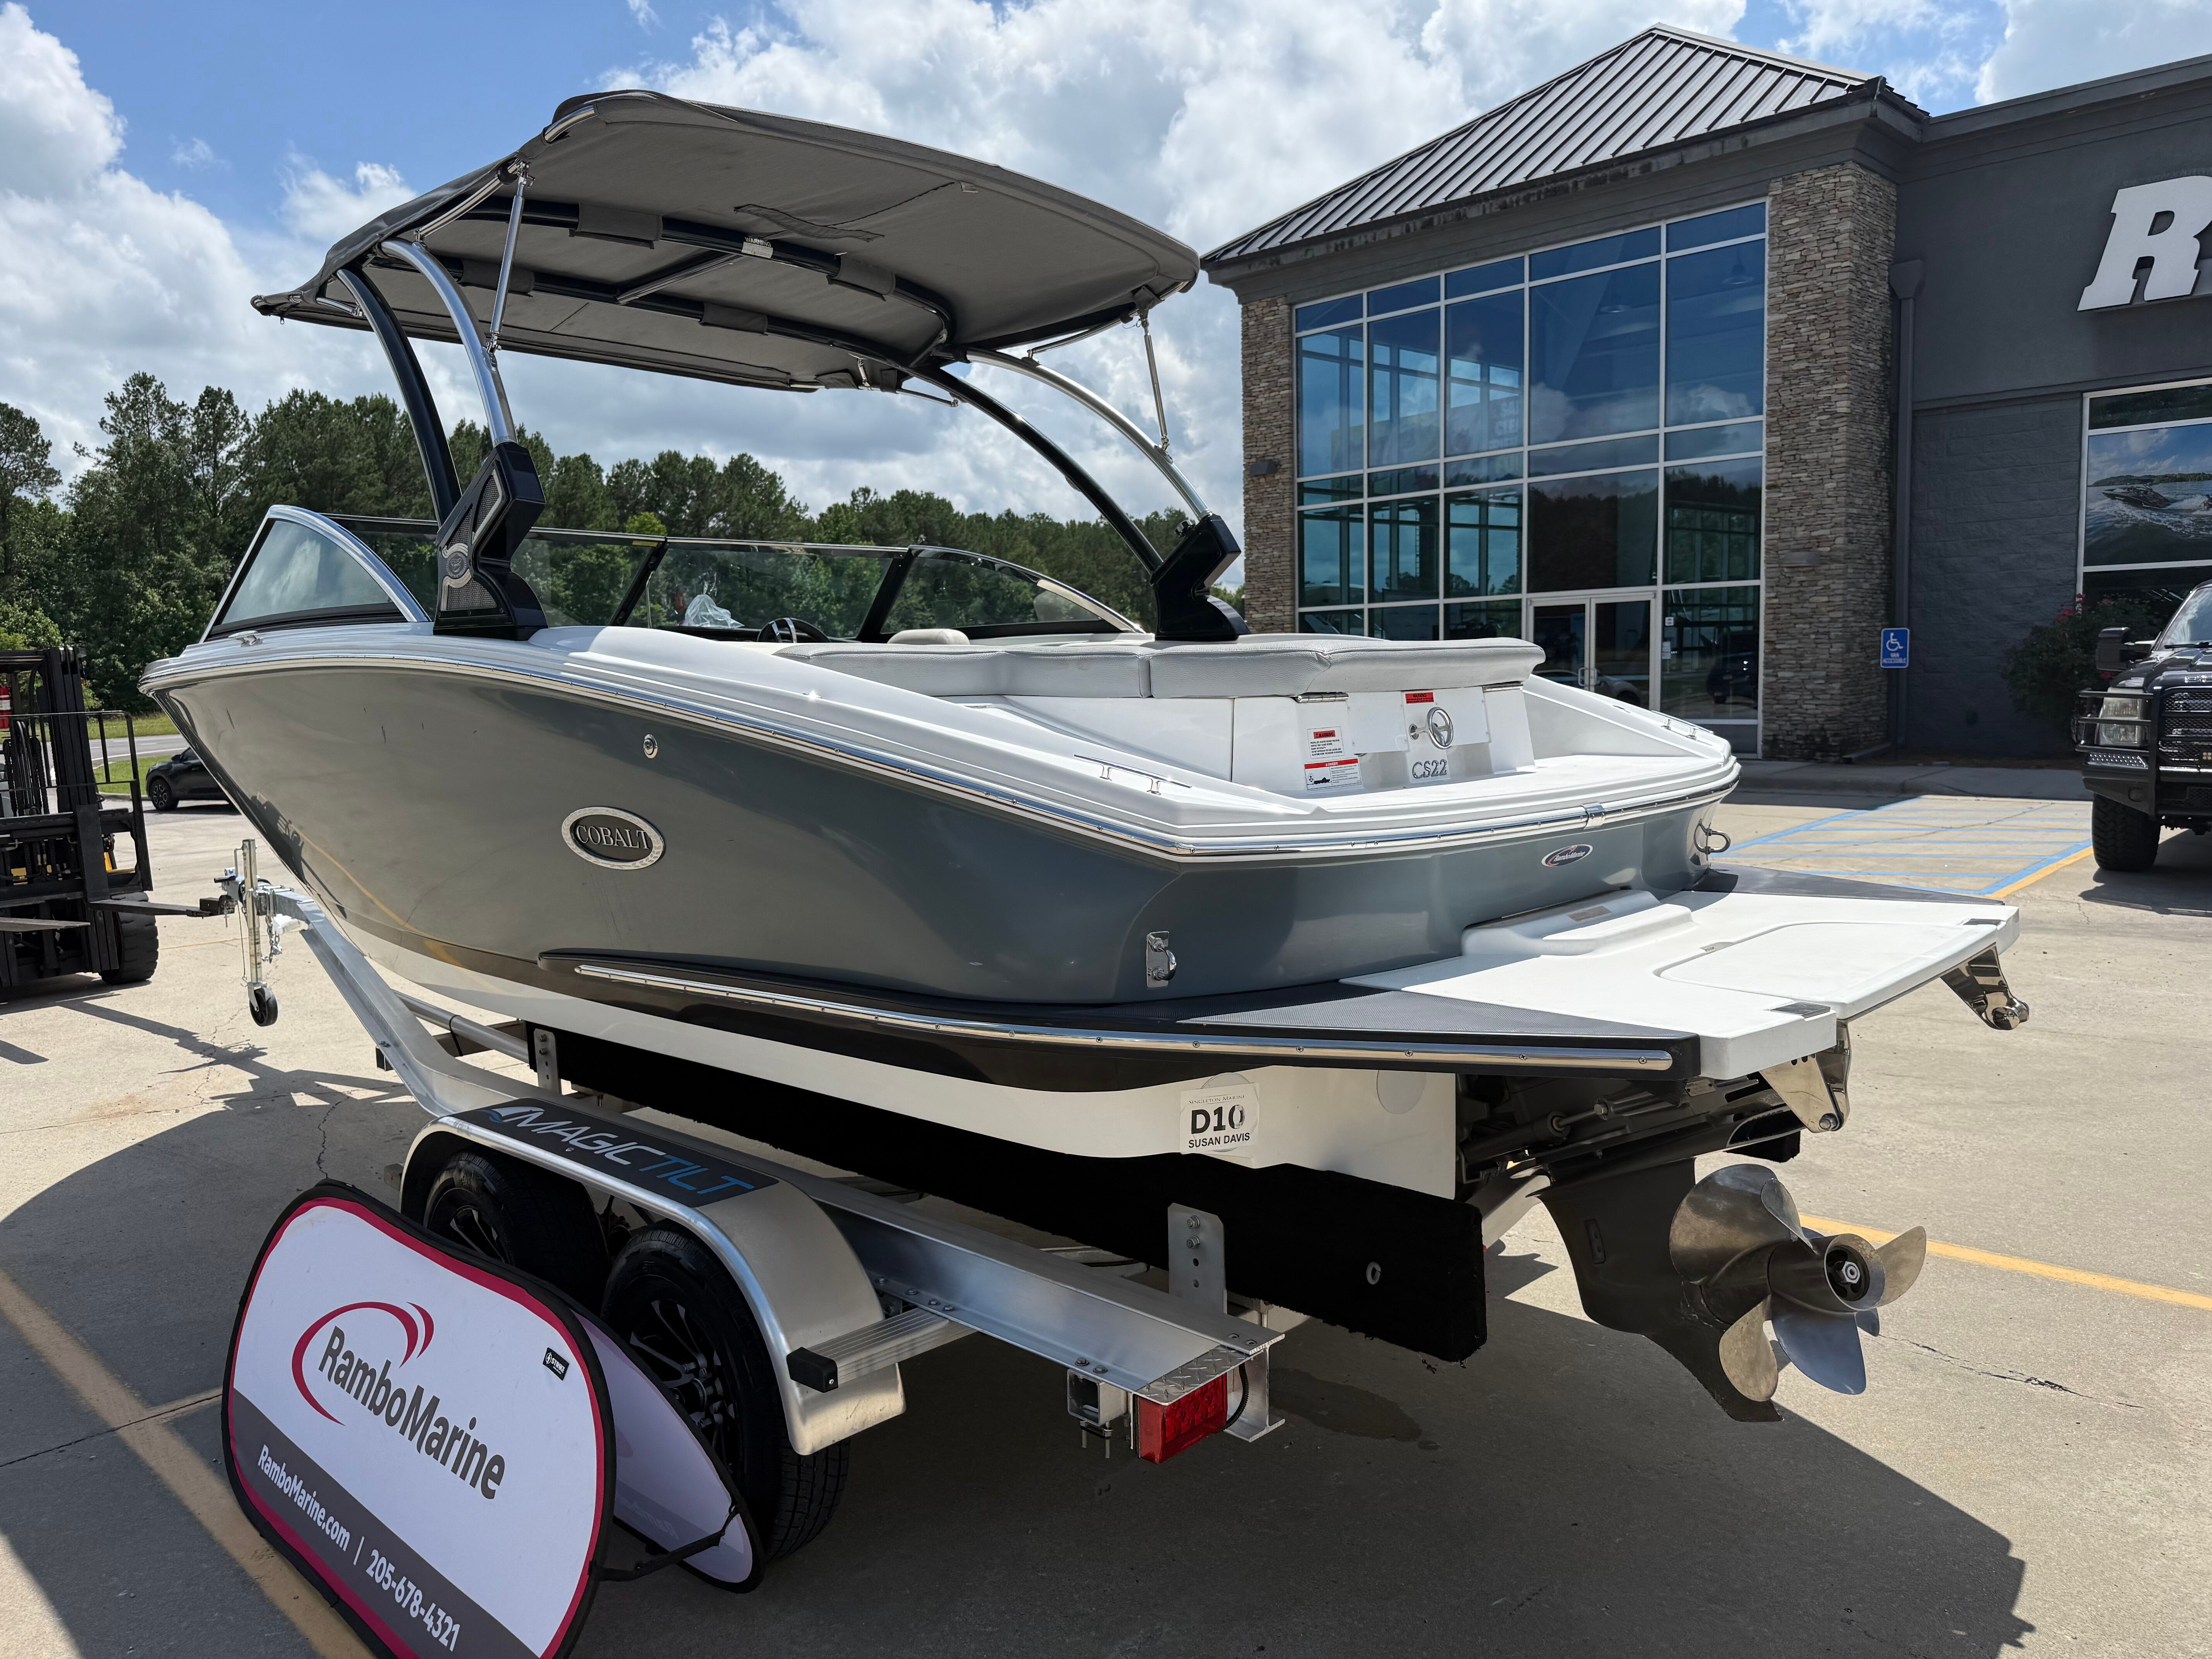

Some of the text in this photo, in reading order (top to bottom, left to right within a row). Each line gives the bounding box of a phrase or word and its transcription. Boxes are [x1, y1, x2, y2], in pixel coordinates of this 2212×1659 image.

[745, 237, 771, 247] WARNING
[1412, 759, 1447, 779] CS22
[576, 825, 650, 849] COBALT
[1191, 1104, 1245, 1134] D10
[1188, 1132, 1250, 1148] SUSAN DAVIS
[551, 1358, 565, 1373] STRIKE
[318, 1326, 505, 1499] RamboMarine
[258, 1444, 350, 1551] RamboMarine.com
[366, 1549, 460, 1652] 205-678-4321
